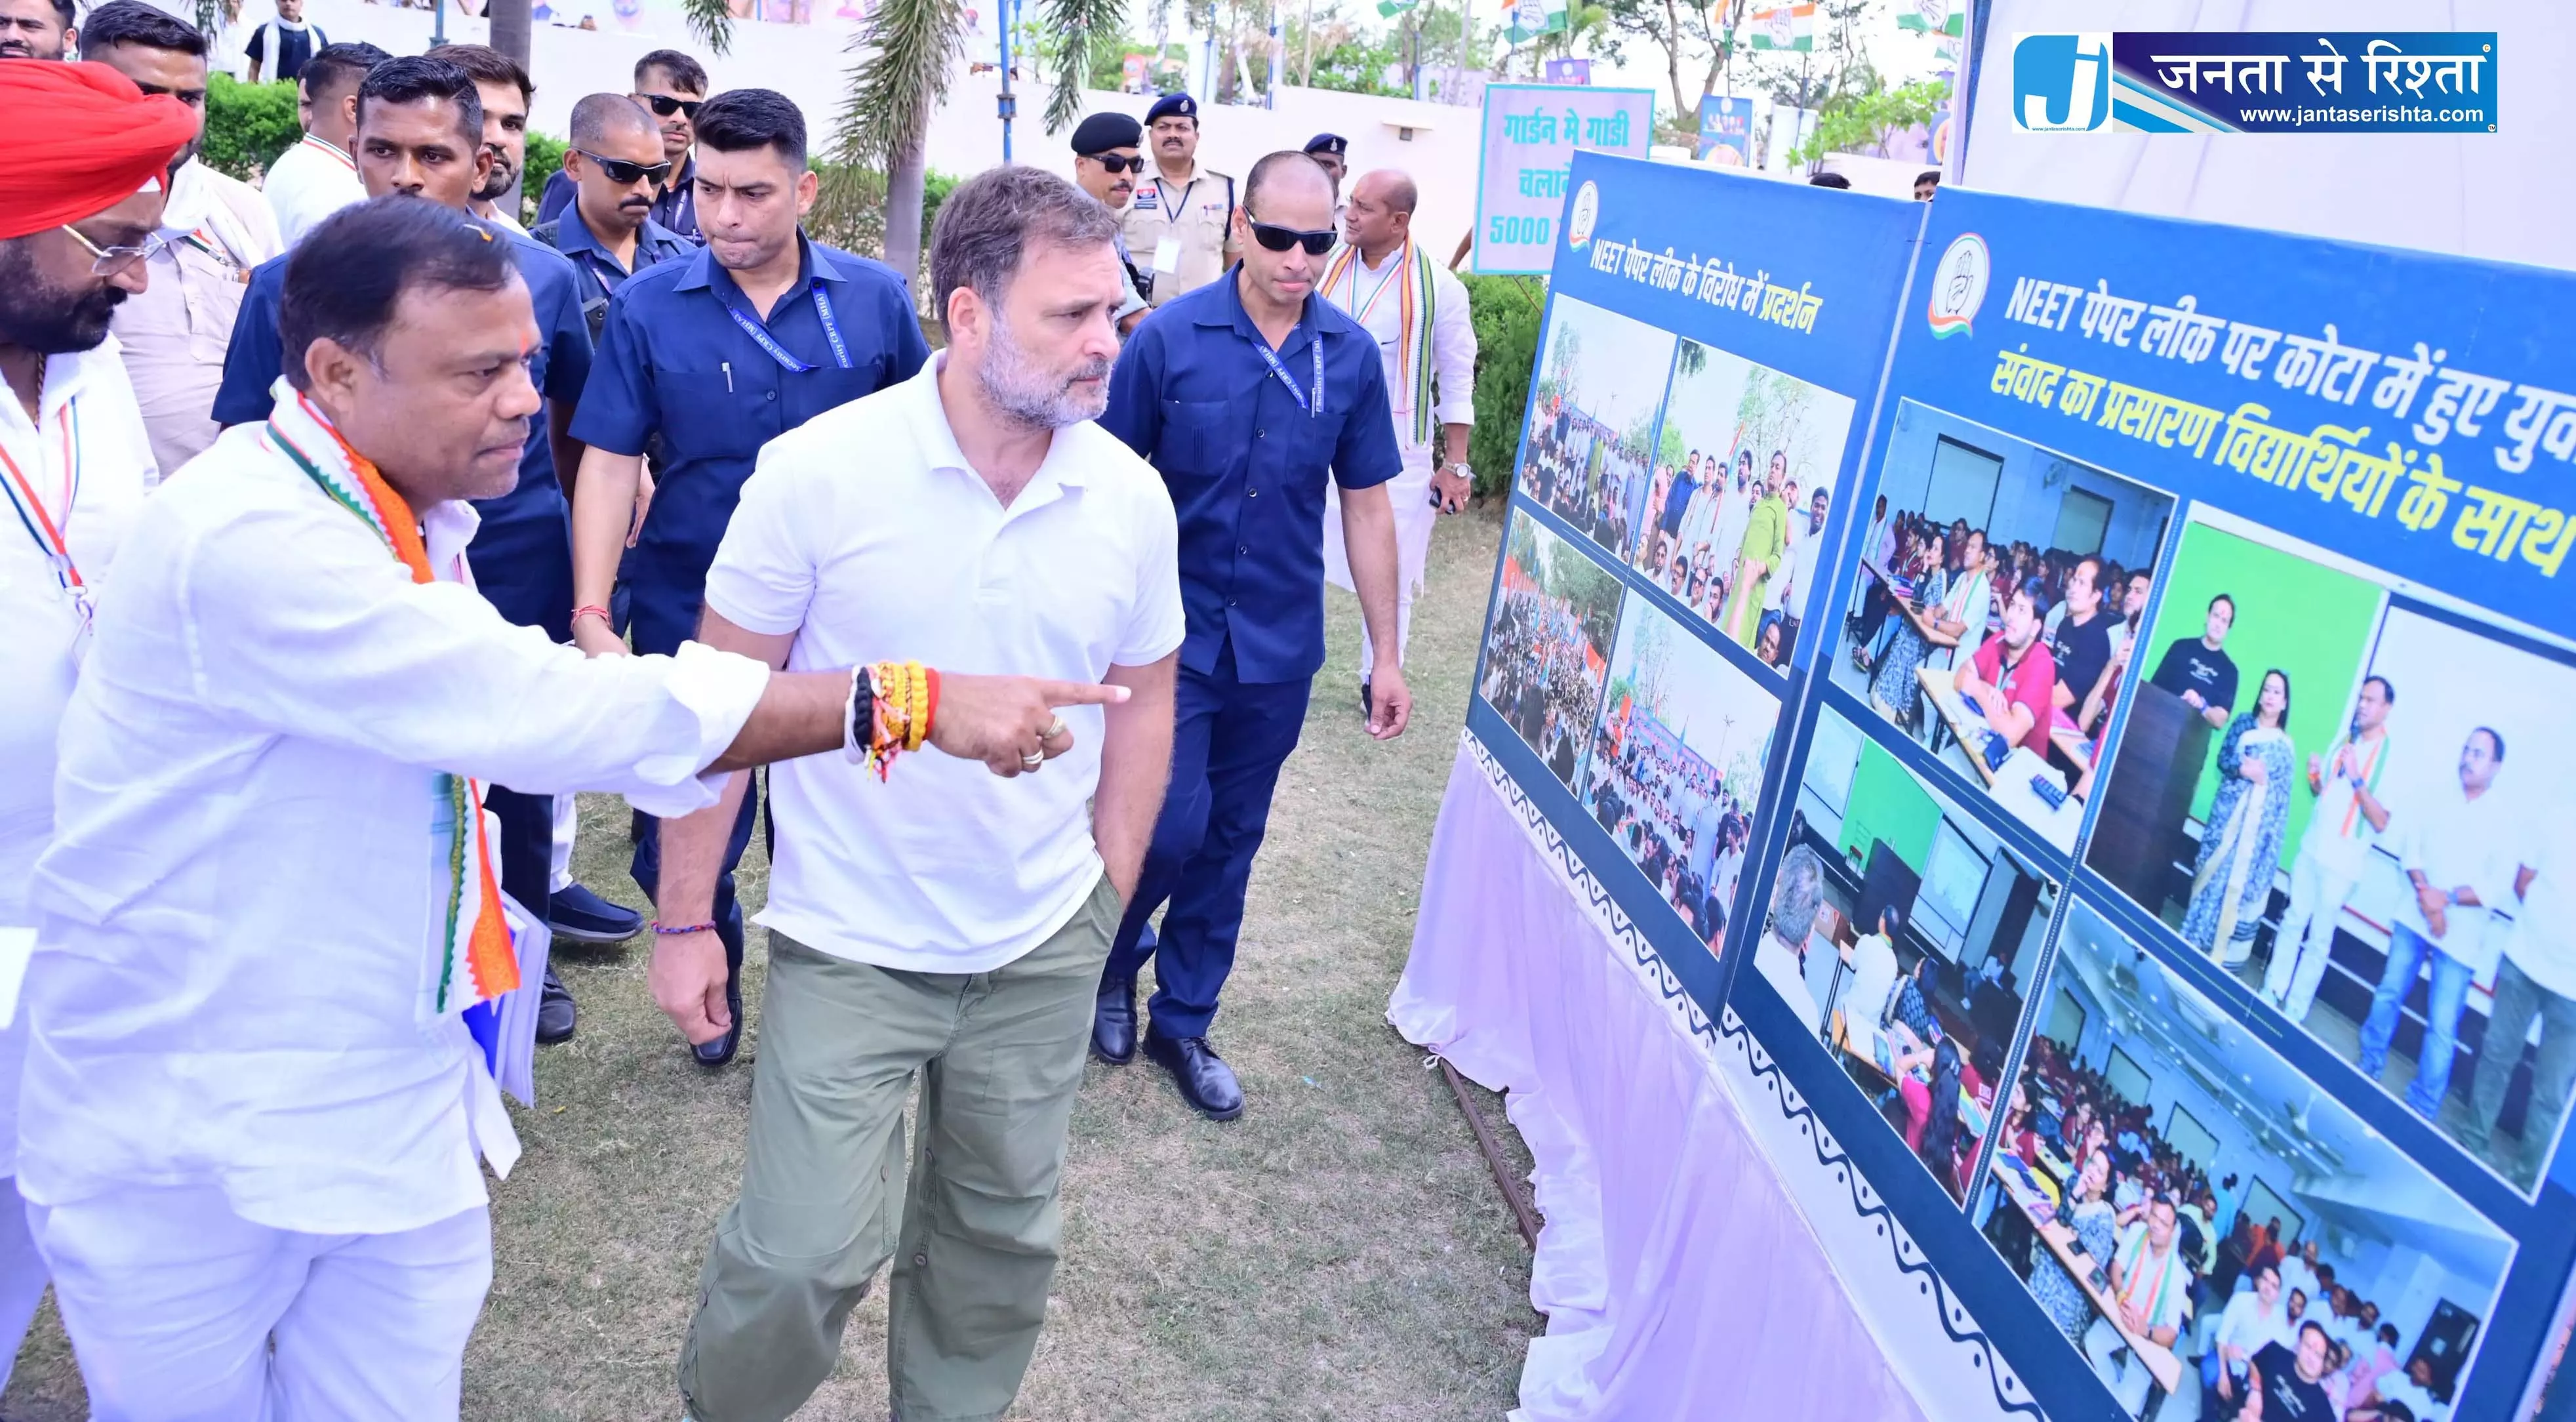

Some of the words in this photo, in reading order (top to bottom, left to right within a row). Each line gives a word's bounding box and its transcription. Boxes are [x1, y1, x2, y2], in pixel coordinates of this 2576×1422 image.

[1504, 106, 1558, 145] गार्डन
[1489, 215, 1550, 245] 5000
[1590, 238, 1626, 275] NEET
[1624, 238, 1654, 283] पेपर
[1649, 247, 1686, 291] लीक
[1681, 253, 1702, 296] के
[1697, 257, 1746, 311] विरोध
[1741, 270, 1769, 316] में
[1758, 281, 1823, 335] प्रदर्शन
[816, 293, 832, 320] (MHA)
[734, 314, 757, 336] (MHA)
[825, 321, 838, 344] CRPF
[755, 333, 773, 352] CRPF
[2004, 276, 2084, 332] NEET
[2080, 278, 2148, 348] पेपर
[2139, 295, 2227, 364] लीक
[2222, 322, 2282, 380] पर
[2273, 323, 2381, 405] कोटा
[2371, 342, 2447, 418] में
[2413, 367, 2512, 445] हुए
[1990, 342, 2066, 409] संवाद
[2059, 369, 2107, 421] का
[2097, 381, 2224, 459] प्रसारण
[2213, 402, 2418, 518] विद्यार्थियों
[2396, 452, 2463, 531] के
[2451, 485, 2576, 579] साथ
